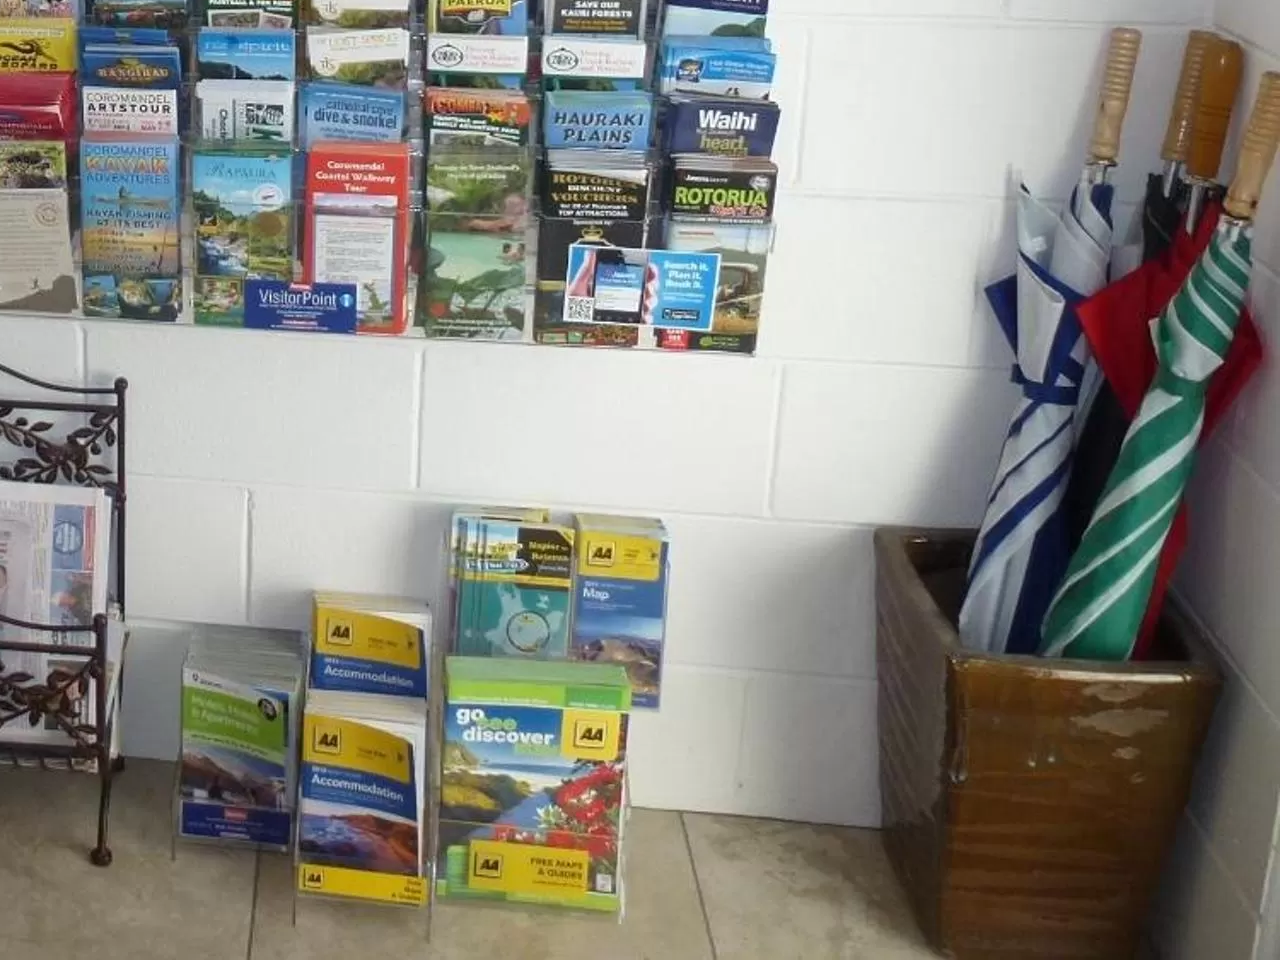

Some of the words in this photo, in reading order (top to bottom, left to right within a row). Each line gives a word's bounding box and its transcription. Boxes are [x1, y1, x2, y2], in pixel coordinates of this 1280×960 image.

[575, 1, 599, 9] SAVE
[600, 1, 620, 9] OUR
[86, 93, 171, 104] COROMANDEL
[313, 109, 339, 122] dive
[340, 113, 350, 123] &
[352, 111, 397, 129] snorkel
[554, 111, 644, 127] HAURAKI
[699, 109, 758, 131] Waihi
[563, 128, 632, 144] PLAINS
[326, 161, 385, 171] Coromandel
[674, 186, 768, 207] ROTORUA
[591, 546, 613, 560] AA
[583, 588, 610, 601] Map
[331, 625, 350, 639] AA
[324, 665, 414, 688] Accommodation
[456, 708, 485, 726] go
[319, 733, 338, 748] AA
[463, 727, 555, 746] discover
[580, 727, 604, 742] AA
[311, 774, 404, 803] Accommodation
[480, 859, 499, 871] AA
[530, 856, 553, 868] FREE
[555, 859, 584, 870] MAPS
[307, 872, 322, 883] AA
[537, 867, 545, 876] &
